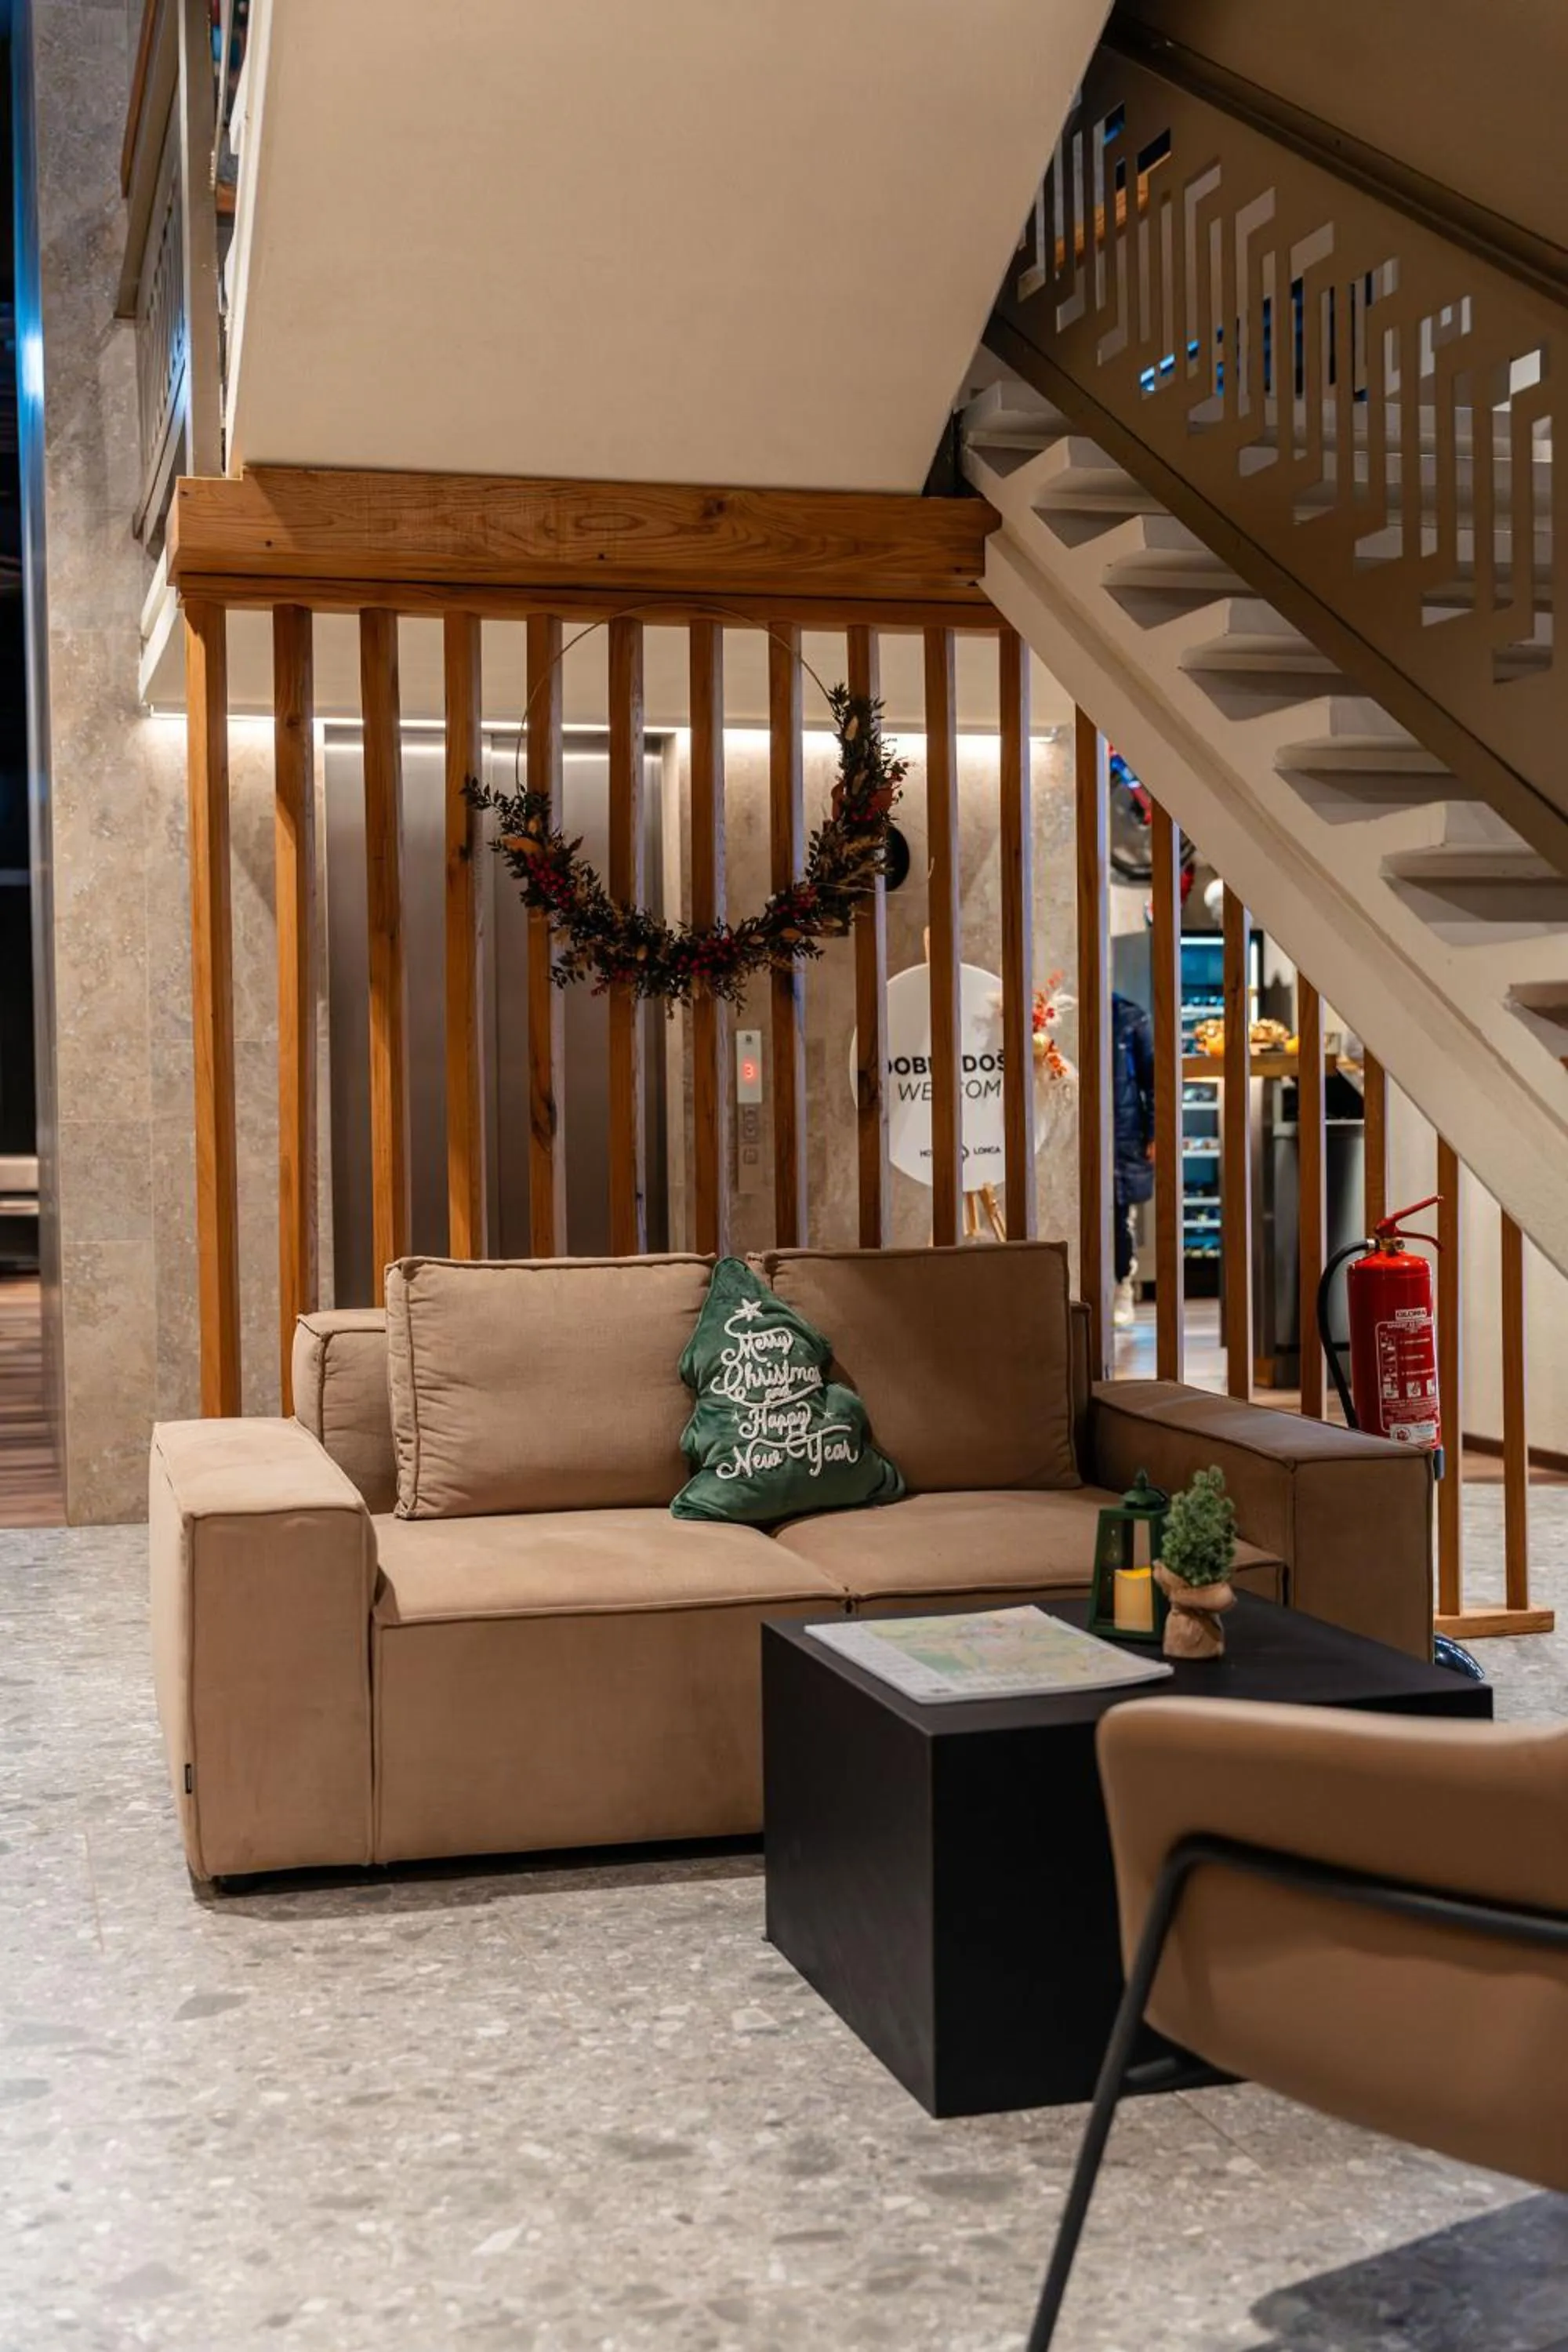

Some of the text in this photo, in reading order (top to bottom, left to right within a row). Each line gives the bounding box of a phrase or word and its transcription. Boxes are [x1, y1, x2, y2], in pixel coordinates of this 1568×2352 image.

[744, 1063, 753, 1078] 3
[720, 1327, 794, 1365] Merry
[710, 1359, 823, 1397] Christmas
[764, 1385, 792, 1403] and
[739, 1403, 811, 1439] Happy
[716, 1427, 860, 1479] New Year
